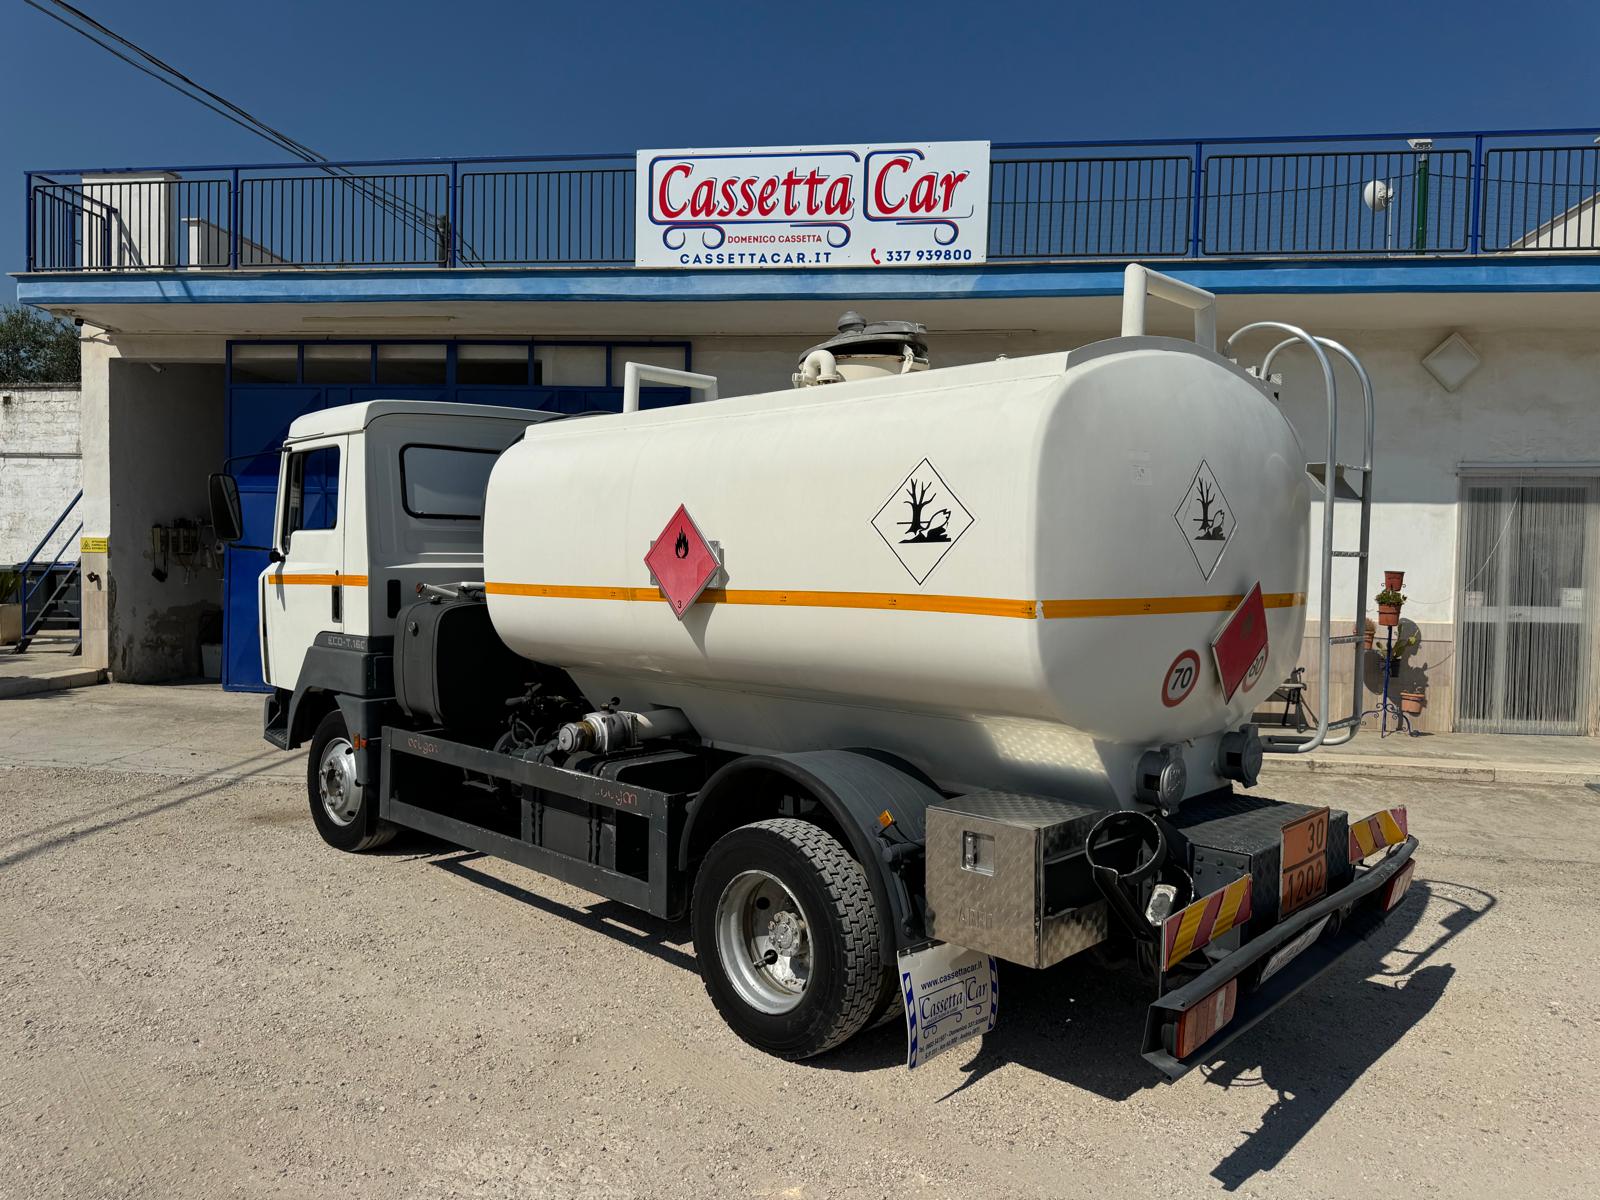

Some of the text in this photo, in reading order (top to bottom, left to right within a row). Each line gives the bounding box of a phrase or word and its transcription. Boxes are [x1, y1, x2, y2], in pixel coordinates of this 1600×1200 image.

[658, 156, 970, 219] Cassetta Car
[727, 233, 822, 244] DOMENICO CASSETTA
[680, 252, 832, 264] CASSETTACAR.IT
[886, 249, 972, 262] 337 939800
[677, 600, 682, 609] 3
[1171, 667, 1193, 691] 70
[1308, 820, 1324, 854] 30
[1288, 860, 1322, 909] 1202
[920, 960, 983, 990] www.cassettacar.it
[921, 991, 963, 1020] Cassetta
[967, 980, 988, 1002] Car
